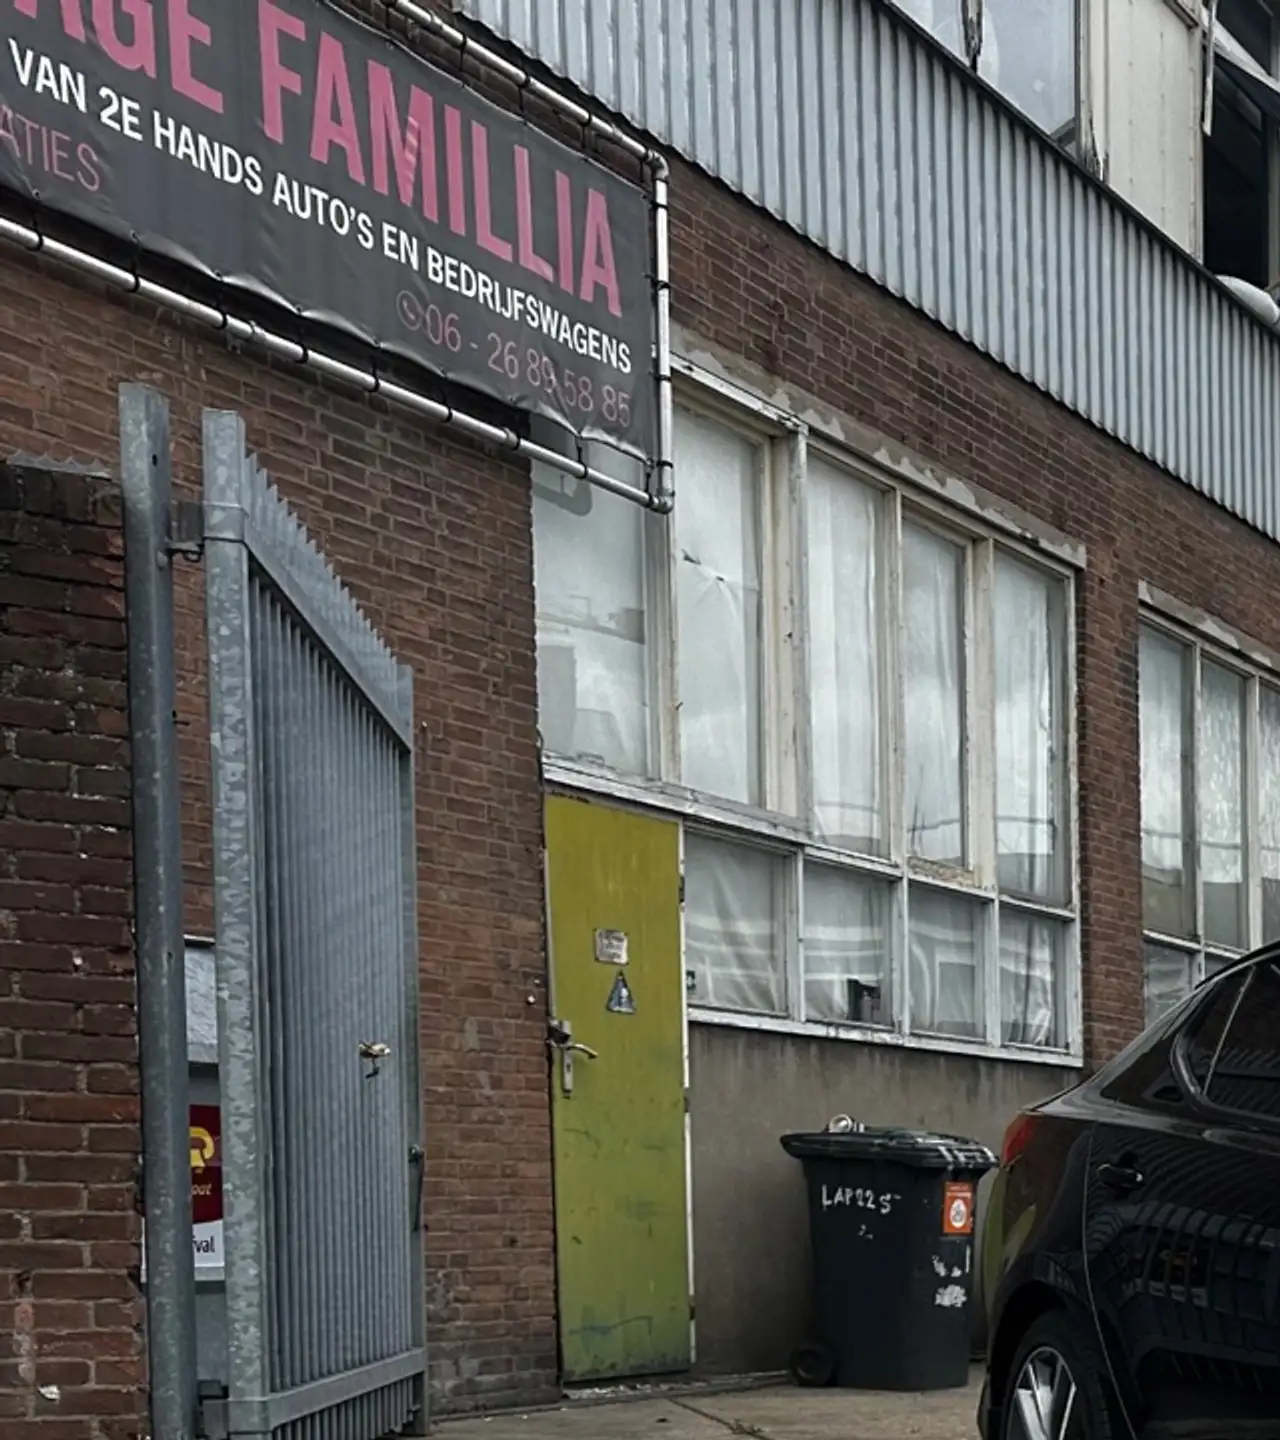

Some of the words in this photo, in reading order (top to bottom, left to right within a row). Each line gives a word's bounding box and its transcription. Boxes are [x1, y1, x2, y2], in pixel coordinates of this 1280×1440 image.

[8, 37, 87, 114] VAN
[98, 86, 143, 141] 2E
[153, 109, 264, 196] HANDS
[272, 172, 375, 251] AUTO'S
[382, 222, 420, 272] EN
[427, 245, 632, 374] BEDRIJFSWAGENS
[14, 0, 223, 114] GE
[258, 0, 622, 318] FAMILLIA
[425, 304, 462, 352] 06
[487, 332, 520, 379] 26
[564, 368, 594, 412] 58
[602, 384, 632, 428] 85
